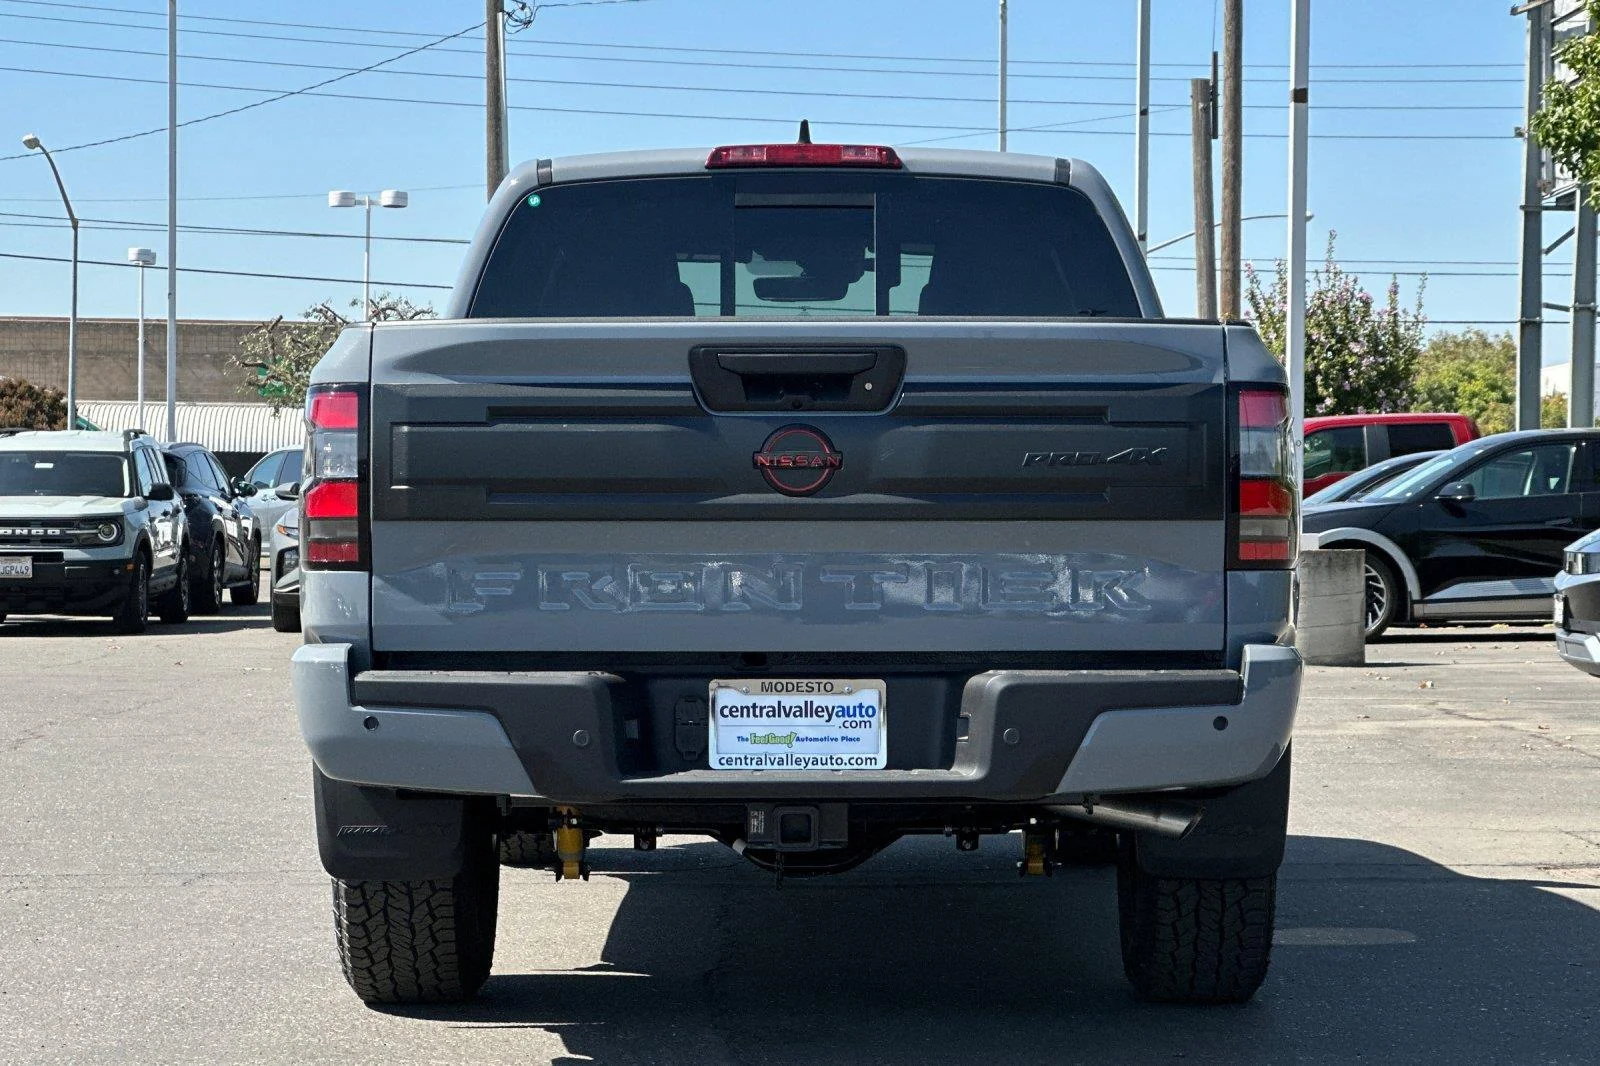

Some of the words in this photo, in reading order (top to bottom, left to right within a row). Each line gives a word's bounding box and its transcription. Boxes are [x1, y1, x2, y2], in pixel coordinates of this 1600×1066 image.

[757, 454, 839, 467] NISSAN
[449, 562, 1152, 611] FRONTIER
[760, 681, 834, 693] MODESTO
[719, 700, 877, 722] centralvalleyauto
[838, 719, 872, 729] .com
[737, 735, 750, 743] The
[795, 735, 839, 743] Automotive
[841, 735, 861, 743] Place
[718, 753, 878, 769] centralvalleyauto.com
